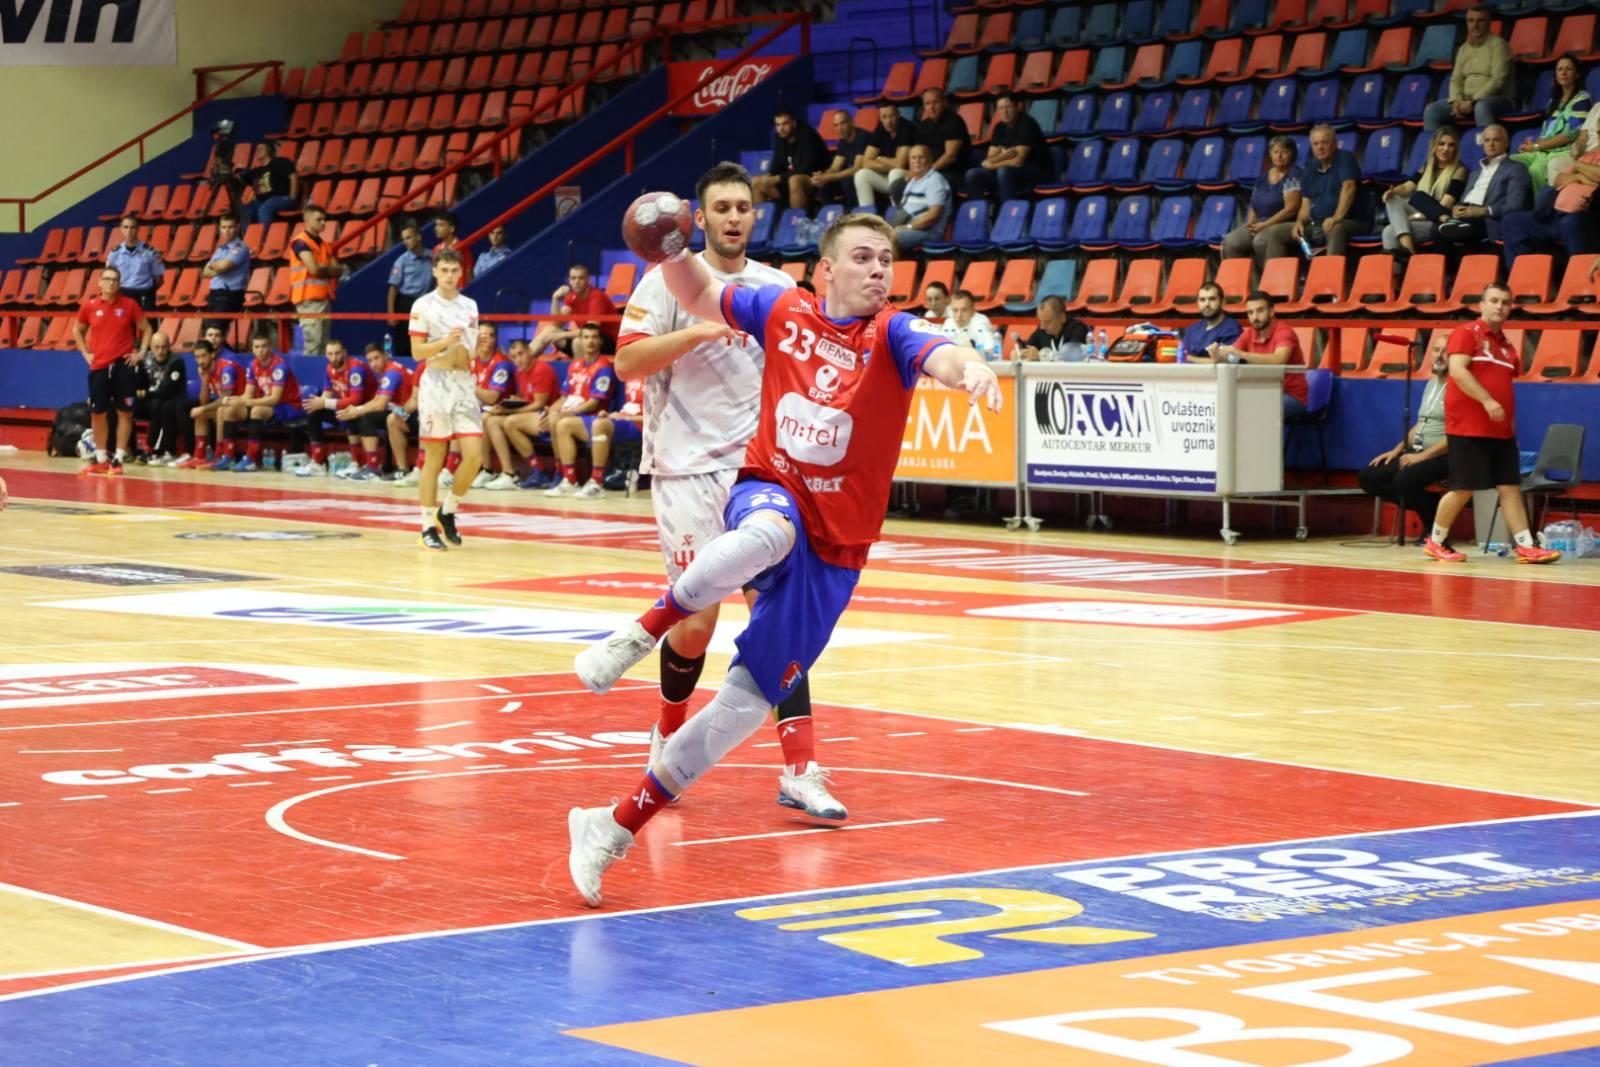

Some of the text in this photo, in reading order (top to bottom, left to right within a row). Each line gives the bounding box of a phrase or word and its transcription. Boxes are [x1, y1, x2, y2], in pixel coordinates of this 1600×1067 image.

[778, 321, 816, 361] 23
[818, 340, 855, 364] BEMA
[808, 386, 833, 403] EPC
[1162, 400, 1216, 417] Ovlašteni
[780, 415, 840, 448] m:tel
[1171, 418, 1216, 433] uvoznik
[1041, 438, 1152, 453] AUTOCENTAR MERKUR
[1183, 438, 1215, 454] guma
[750, 492, 790, 508] 23
[1052, 848, 1380, 892] PRO
[1120, 851, 1534, 912] RENT
[1120, 931, 1521, 985] TVORNICA
[982, 954, 1600, 1067] BE
